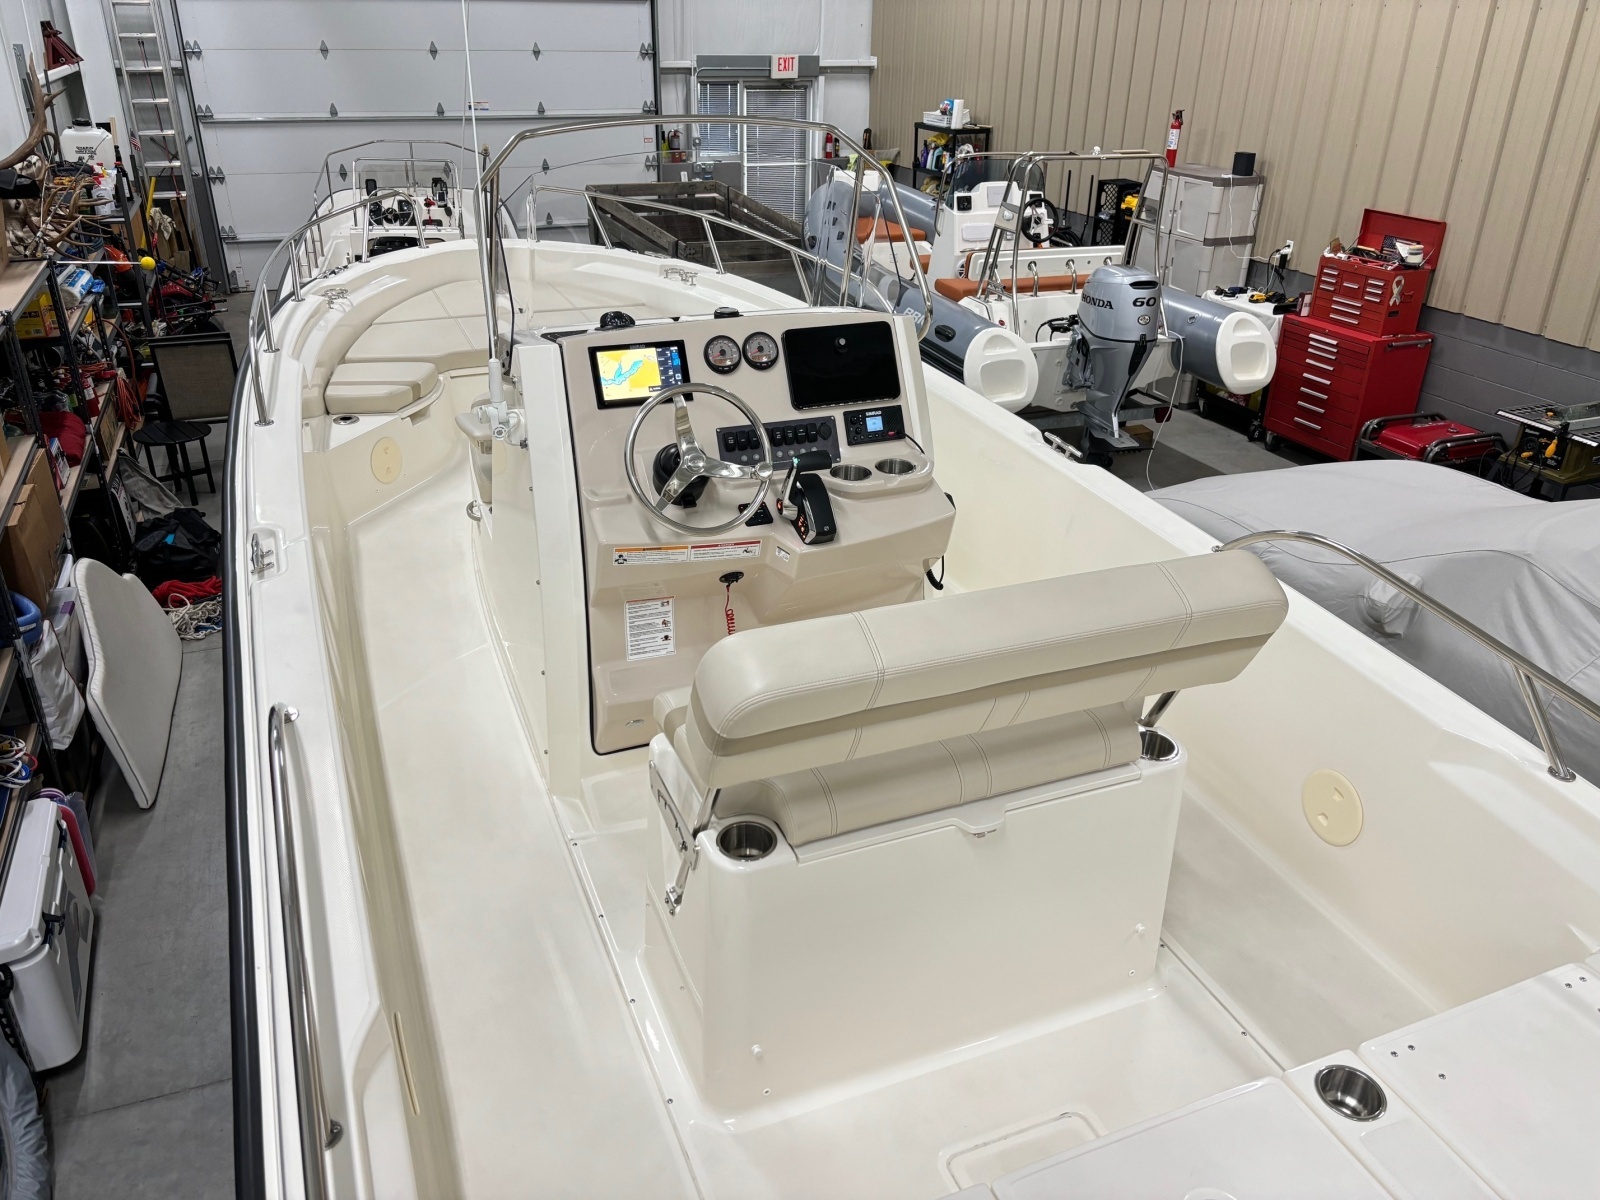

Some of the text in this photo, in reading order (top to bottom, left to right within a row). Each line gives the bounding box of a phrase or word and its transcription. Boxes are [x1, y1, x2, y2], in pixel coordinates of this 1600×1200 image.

[778, 57, 795, 72] EXIT
[1082, 293, 1114, 310] HONDA
[1132, 297, 1157, 307] 60
